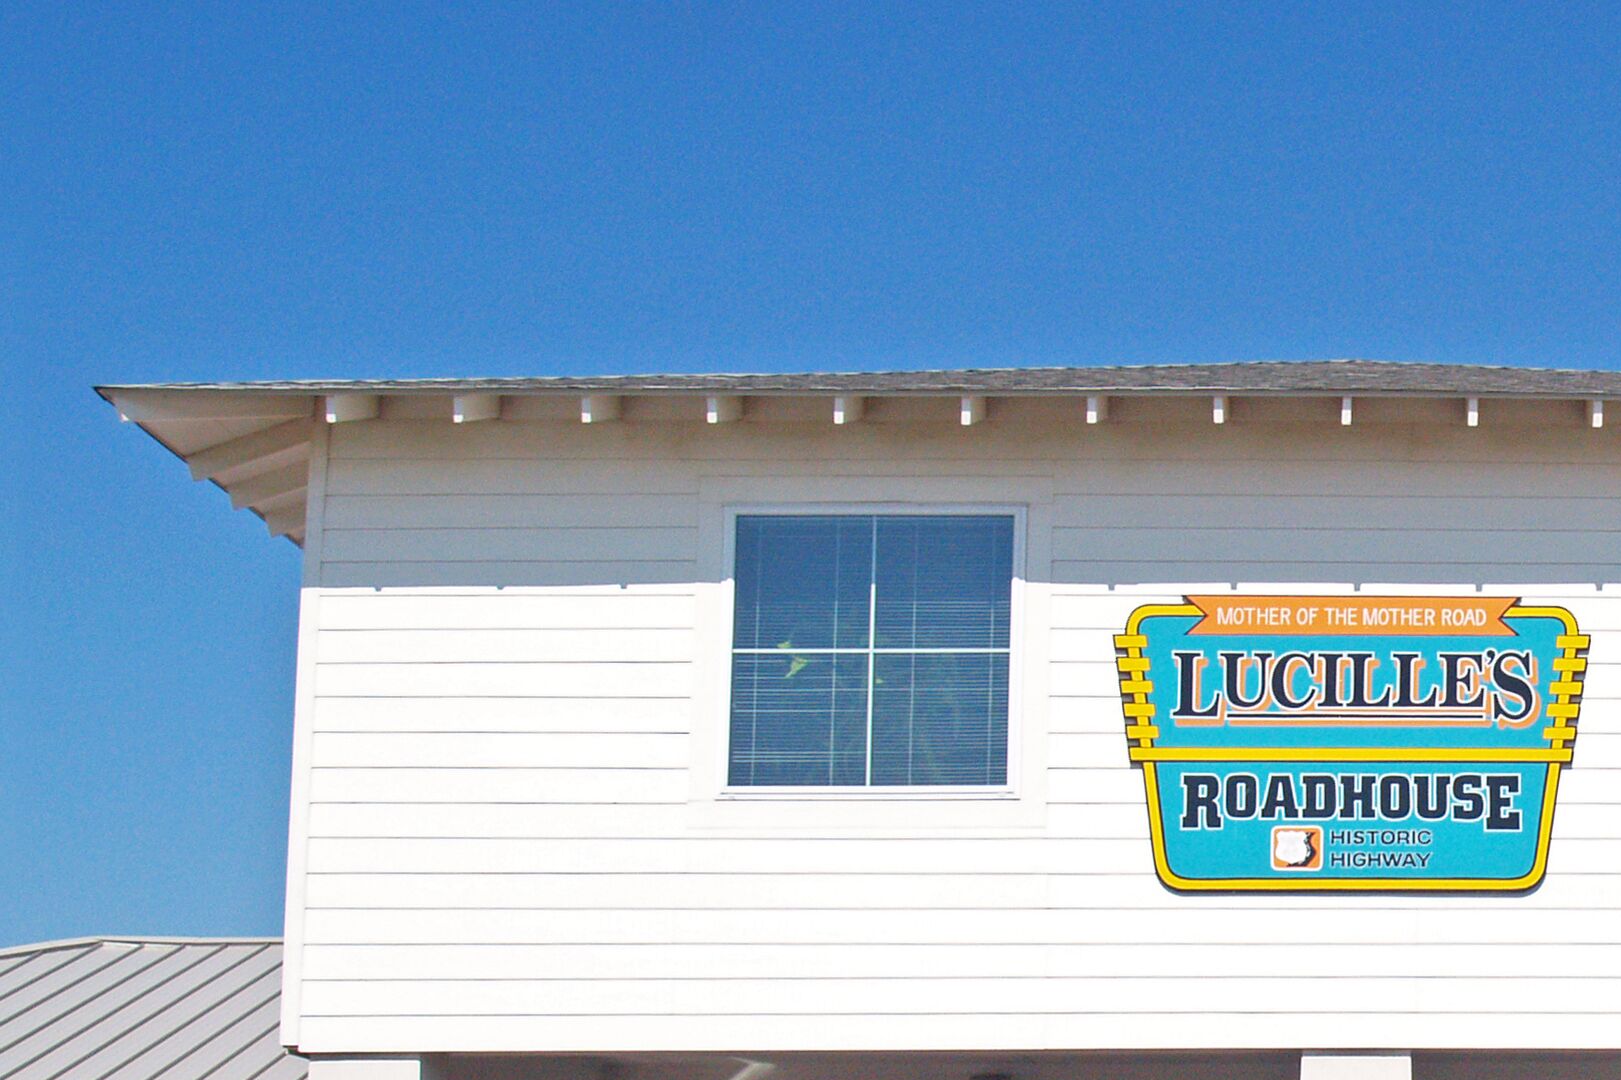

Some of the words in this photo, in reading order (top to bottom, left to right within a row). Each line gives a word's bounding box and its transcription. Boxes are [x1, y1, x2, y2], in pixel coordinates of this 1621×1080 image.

[1216, 606, 1292, 627] MOTHER
[1296, 606, 1319, 626] OF
[1323, 606, 1359, 626] THE
[1362, 606, 1438, 627] MOTHER
[1441, 606, 1488, 627] ROAD
[1172, 649, 1534, 722] LUCILLE'S
[1181, 773, 1521, 830] ROADHOUSE
[1330, 829, 1432, 845] HISTORIC
[1330, 852, 1432, 868] HIGHWAY
